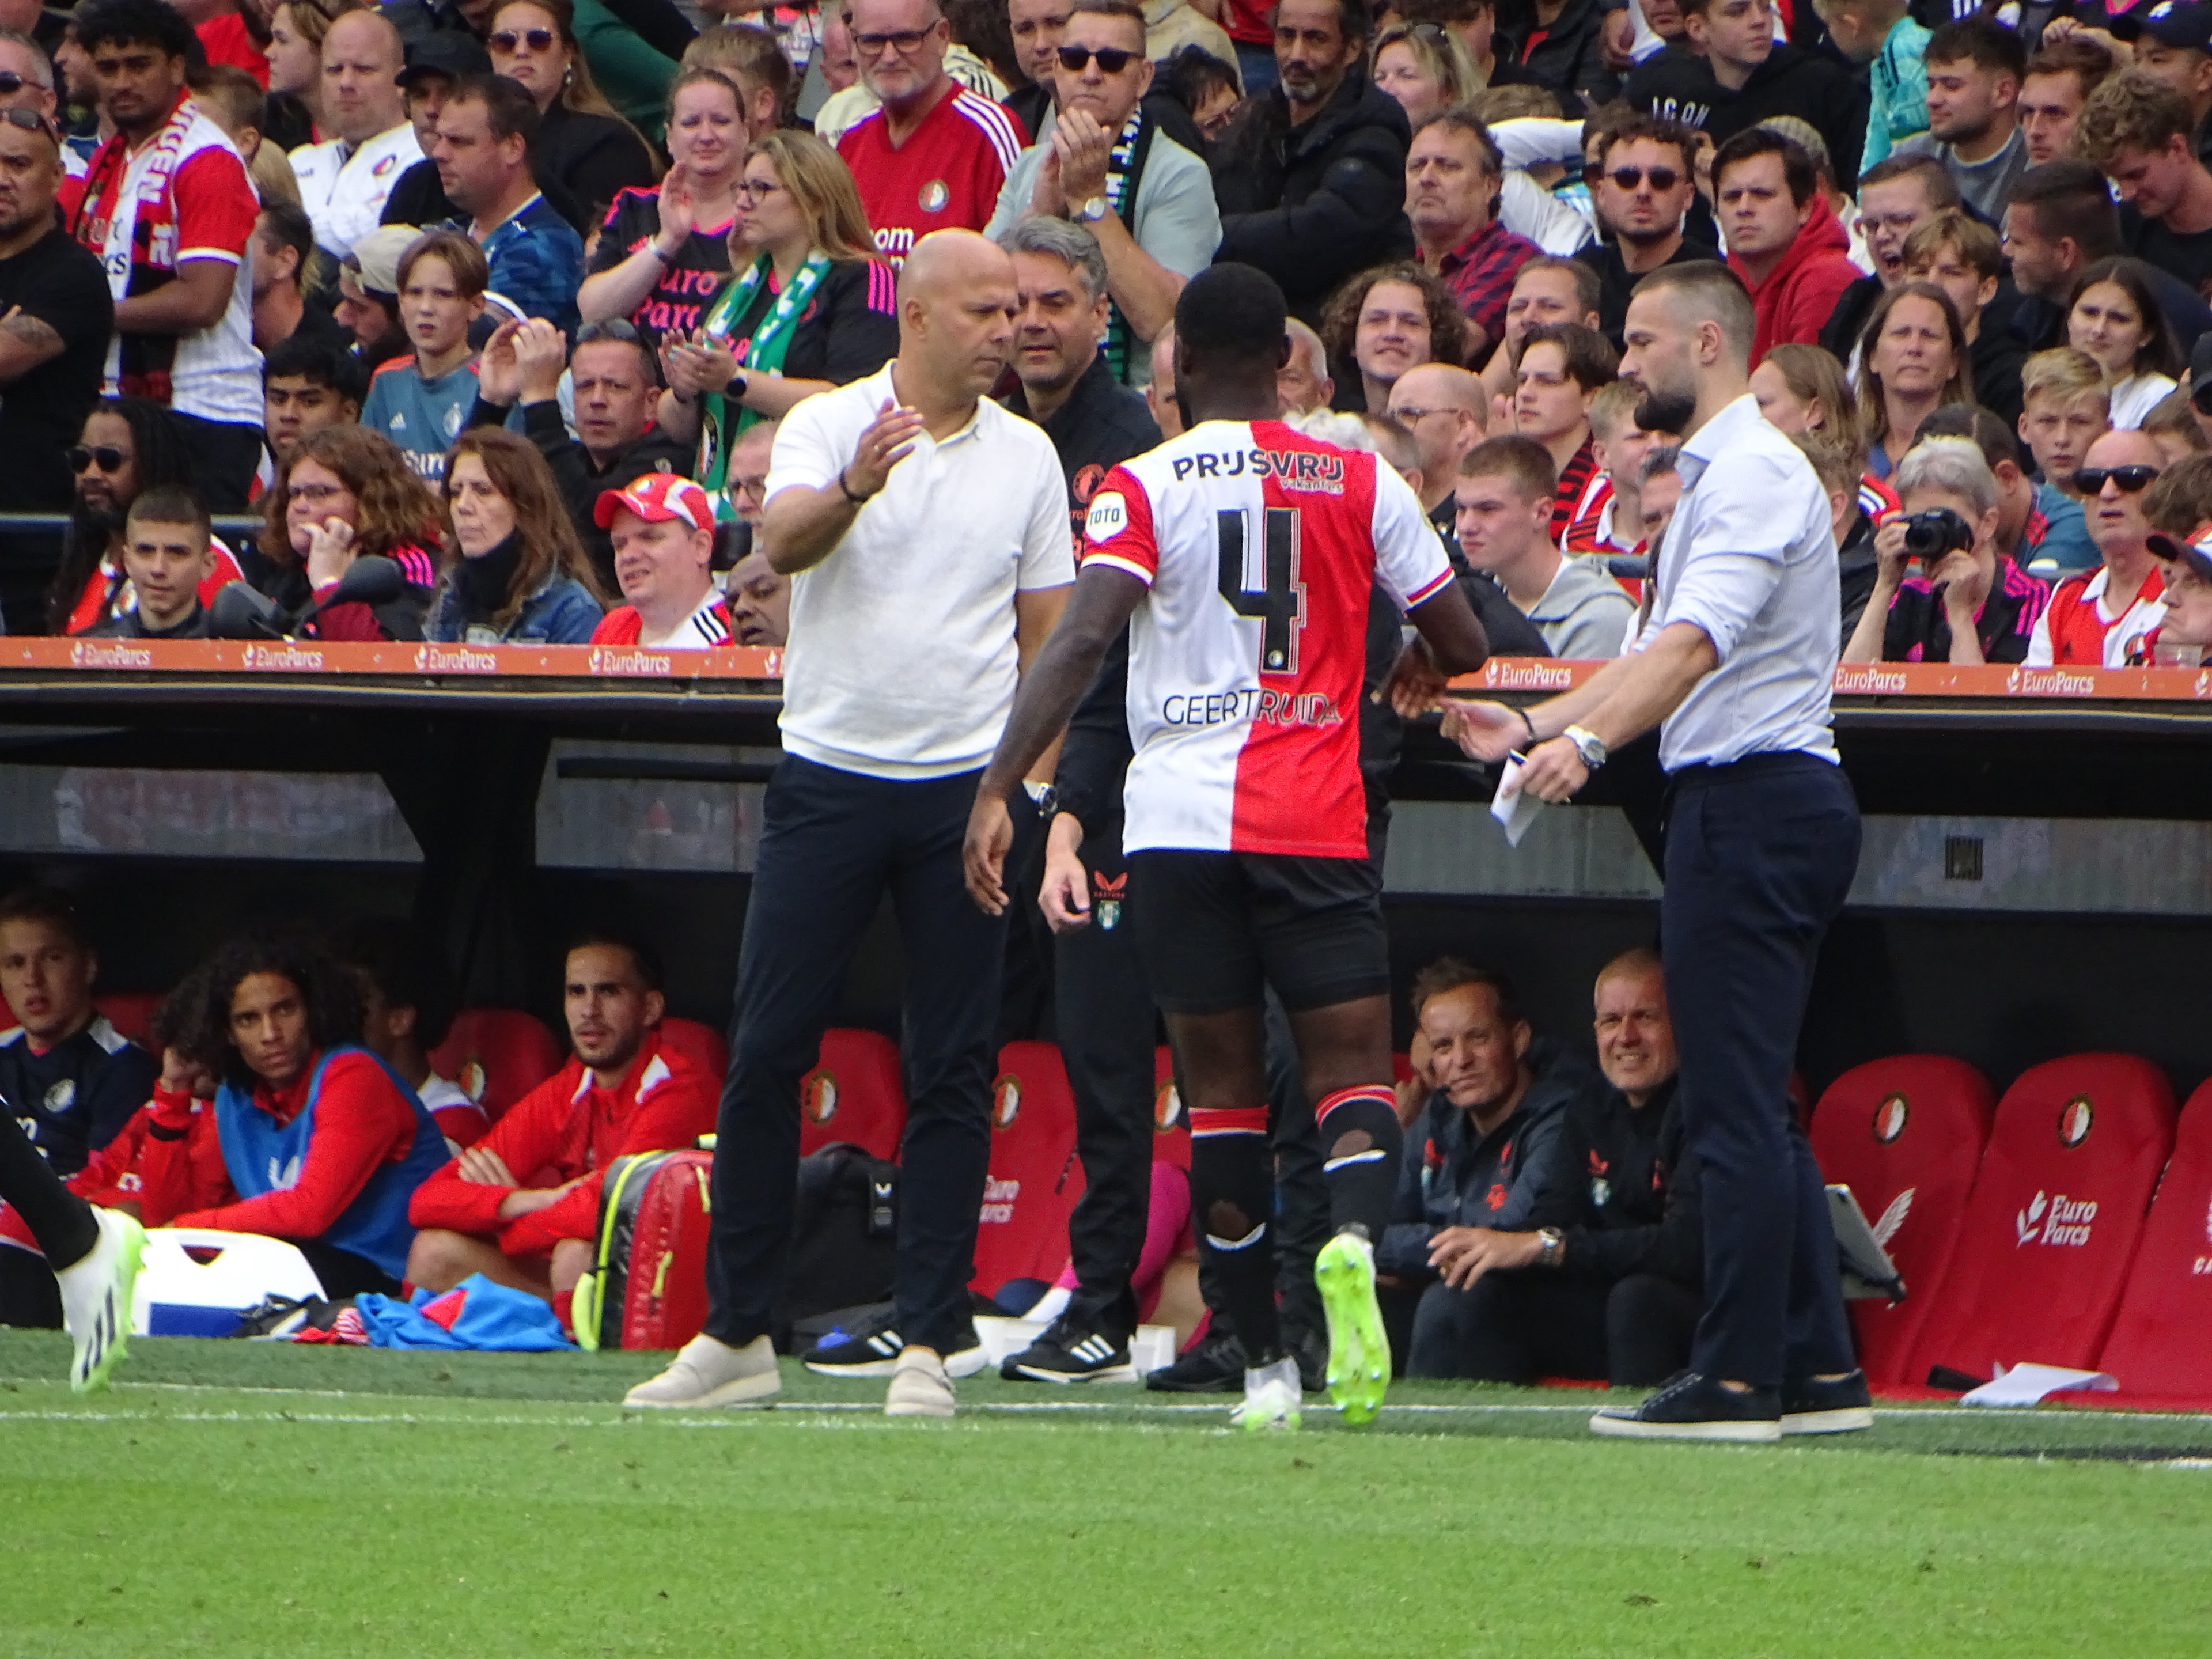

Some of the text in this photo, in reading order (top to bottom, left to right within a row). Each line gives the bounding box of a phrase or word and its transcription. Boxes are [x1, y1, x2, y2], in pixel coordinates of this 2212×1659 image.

[659, 268, 718, 297] uro
[1089, 506, 1120, 527] TOTO
[1217, 507, 1306, 673] 4
[429, 647, 496, 671] EuroParcs
[603, 650, 671, 674] EuroParcs
[1501, 662, 1571, 687] EuroParcs
[1834, 667, 1907, 691] EuroParcs
[2021, 670, 2094, 695] EuroParcs
[1163, 688, 1342, 728] GEERTRUIDA
[2048, 1194, 2099, 1224] Euro
[2040, 1219, 2092, 1247] Parcs
